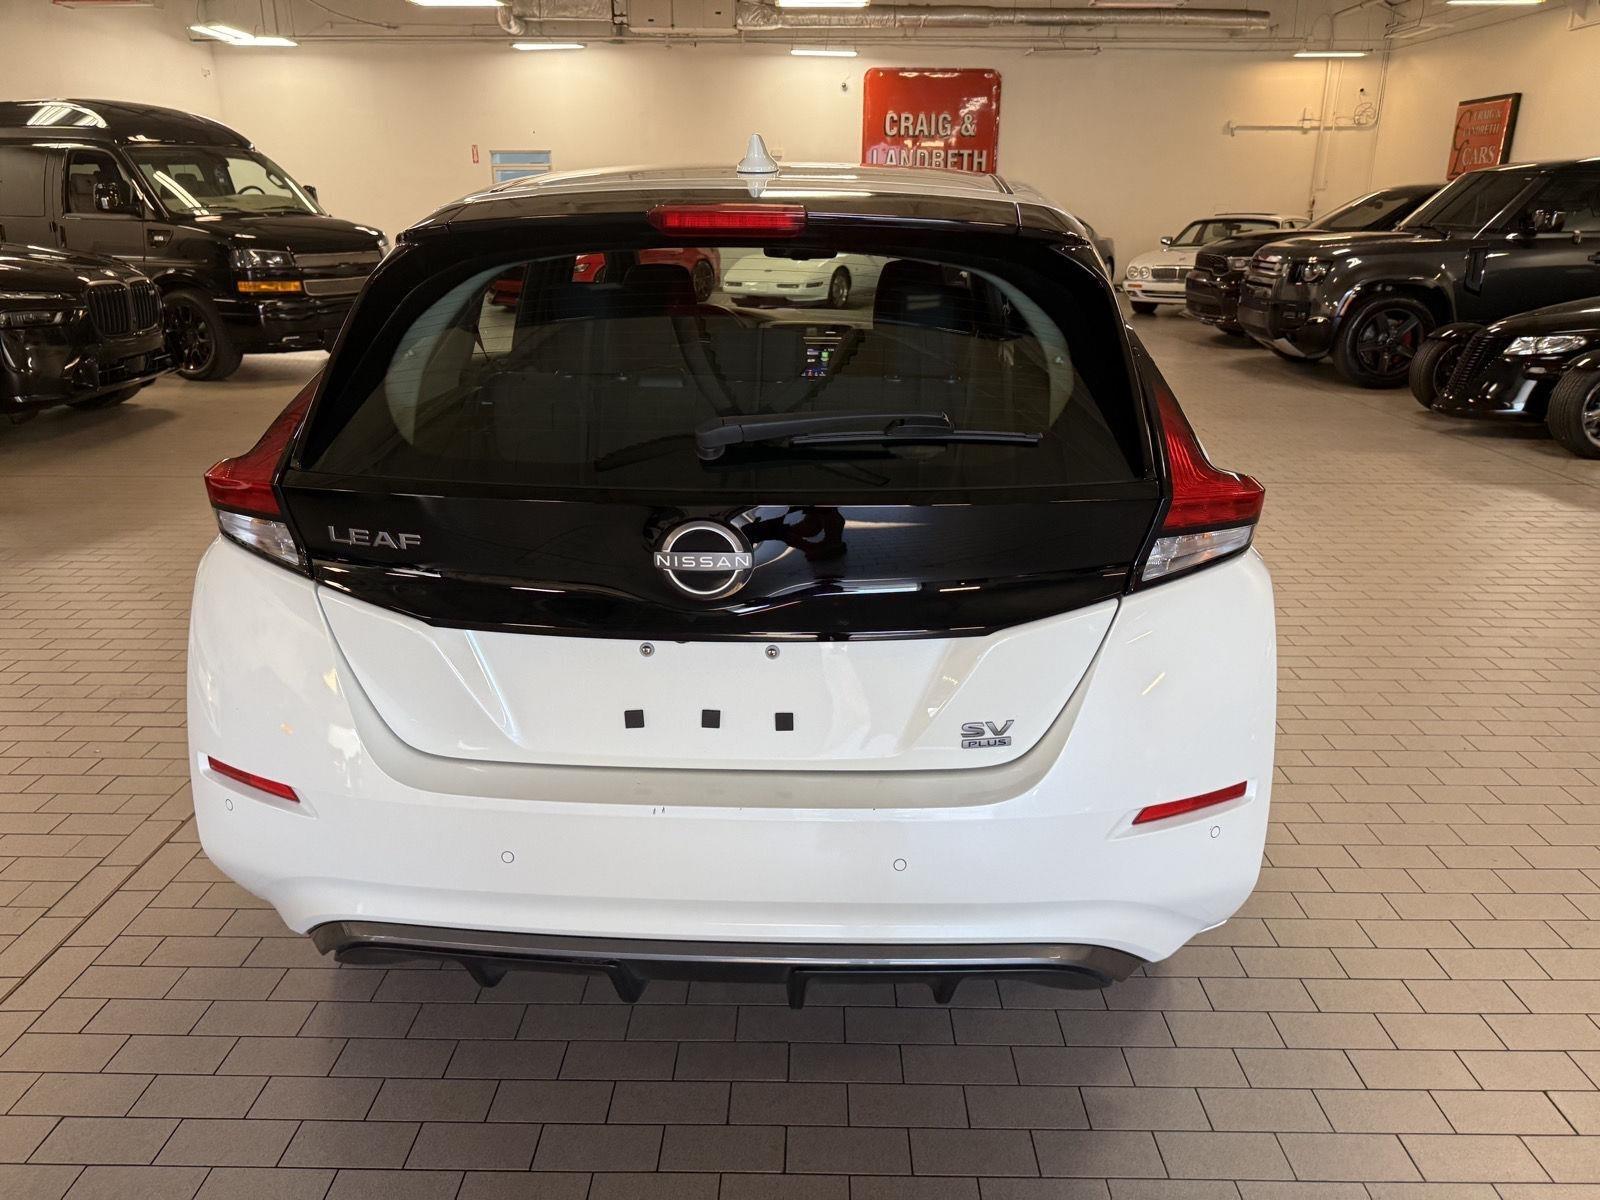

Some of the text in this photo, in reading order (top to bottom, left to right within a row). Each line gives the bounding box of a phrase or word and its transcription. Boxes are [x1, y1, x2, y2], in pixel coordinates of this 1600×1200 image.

[885, 111, 976, 137] CRAIG &
[1462, 145, 1496, 166] CARS
[328, 525, 421, 550] LEAF
[656, 555, 749, 568] NISSAN
[961, 719, 1014, 738] SV
[968, 738, 1007, 748] PLUS
